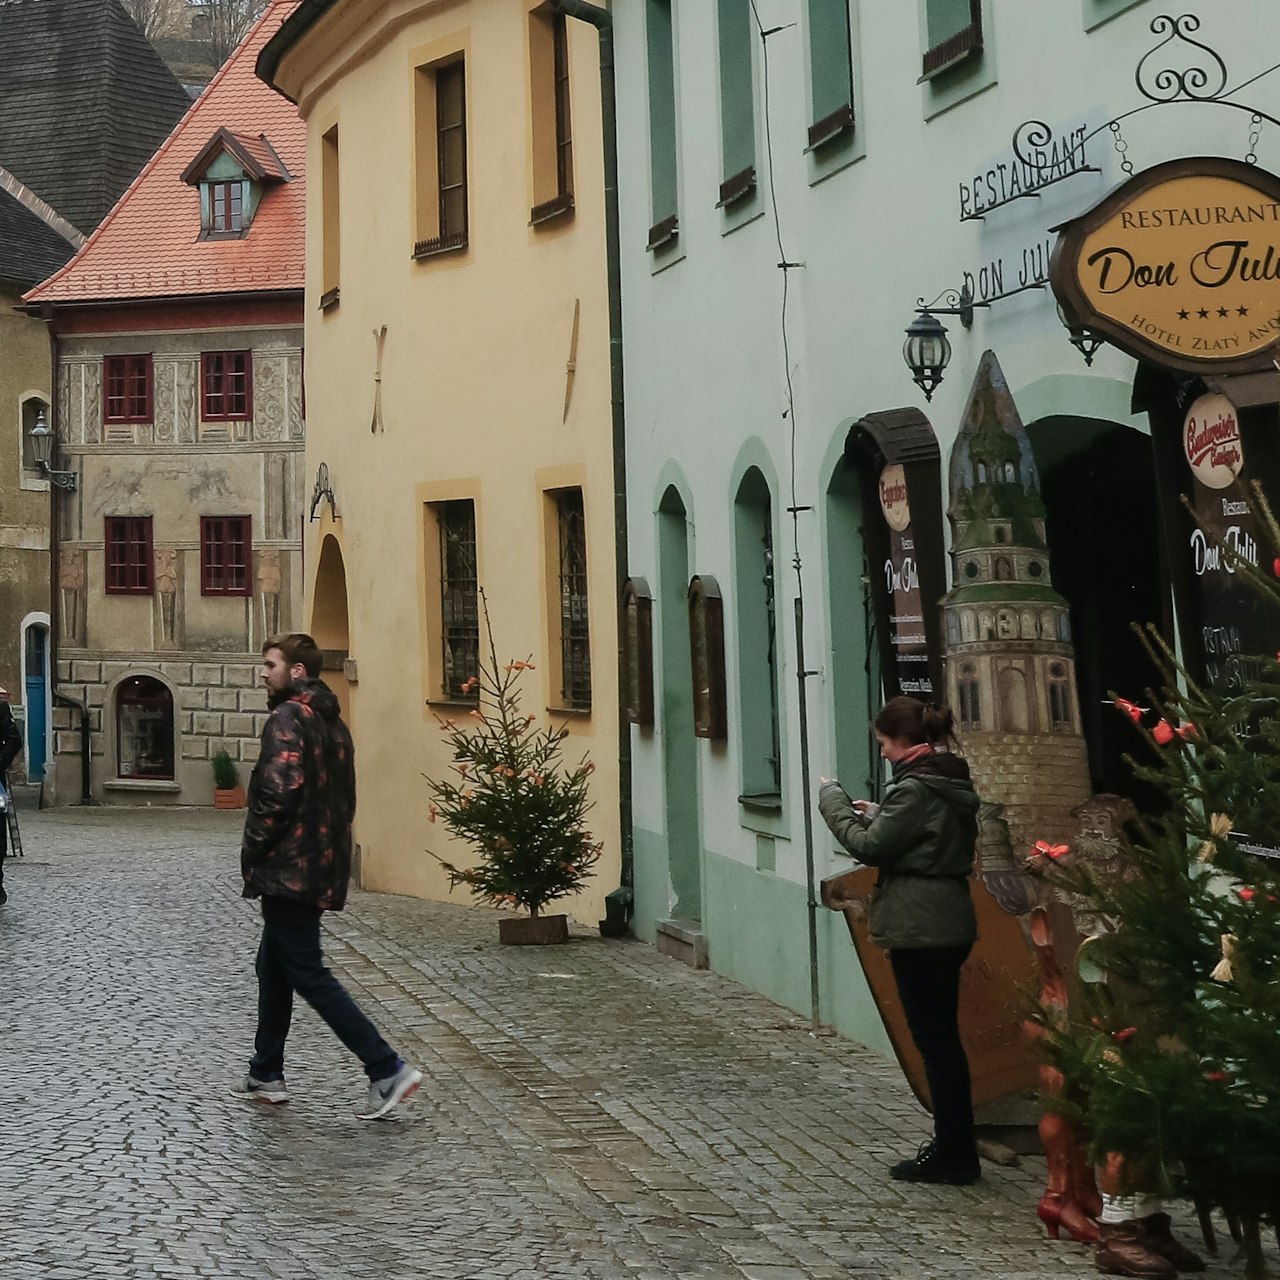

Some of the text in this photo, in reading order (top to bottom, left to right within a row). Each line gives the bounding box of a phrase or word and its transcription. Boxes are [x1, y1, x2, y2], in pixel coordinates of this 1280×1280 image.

[960, 124, 1087, 217] RESTAURANT
[1121, 204, 1280, 230] RESTAURANT
[963, 239, 1051, 304] DON JUL
[1087, 246, 1178, 294] Don
[1131, 314, 1182, 347] HOTEL
[1192, 333, 1240, 351] ZLATÝ
